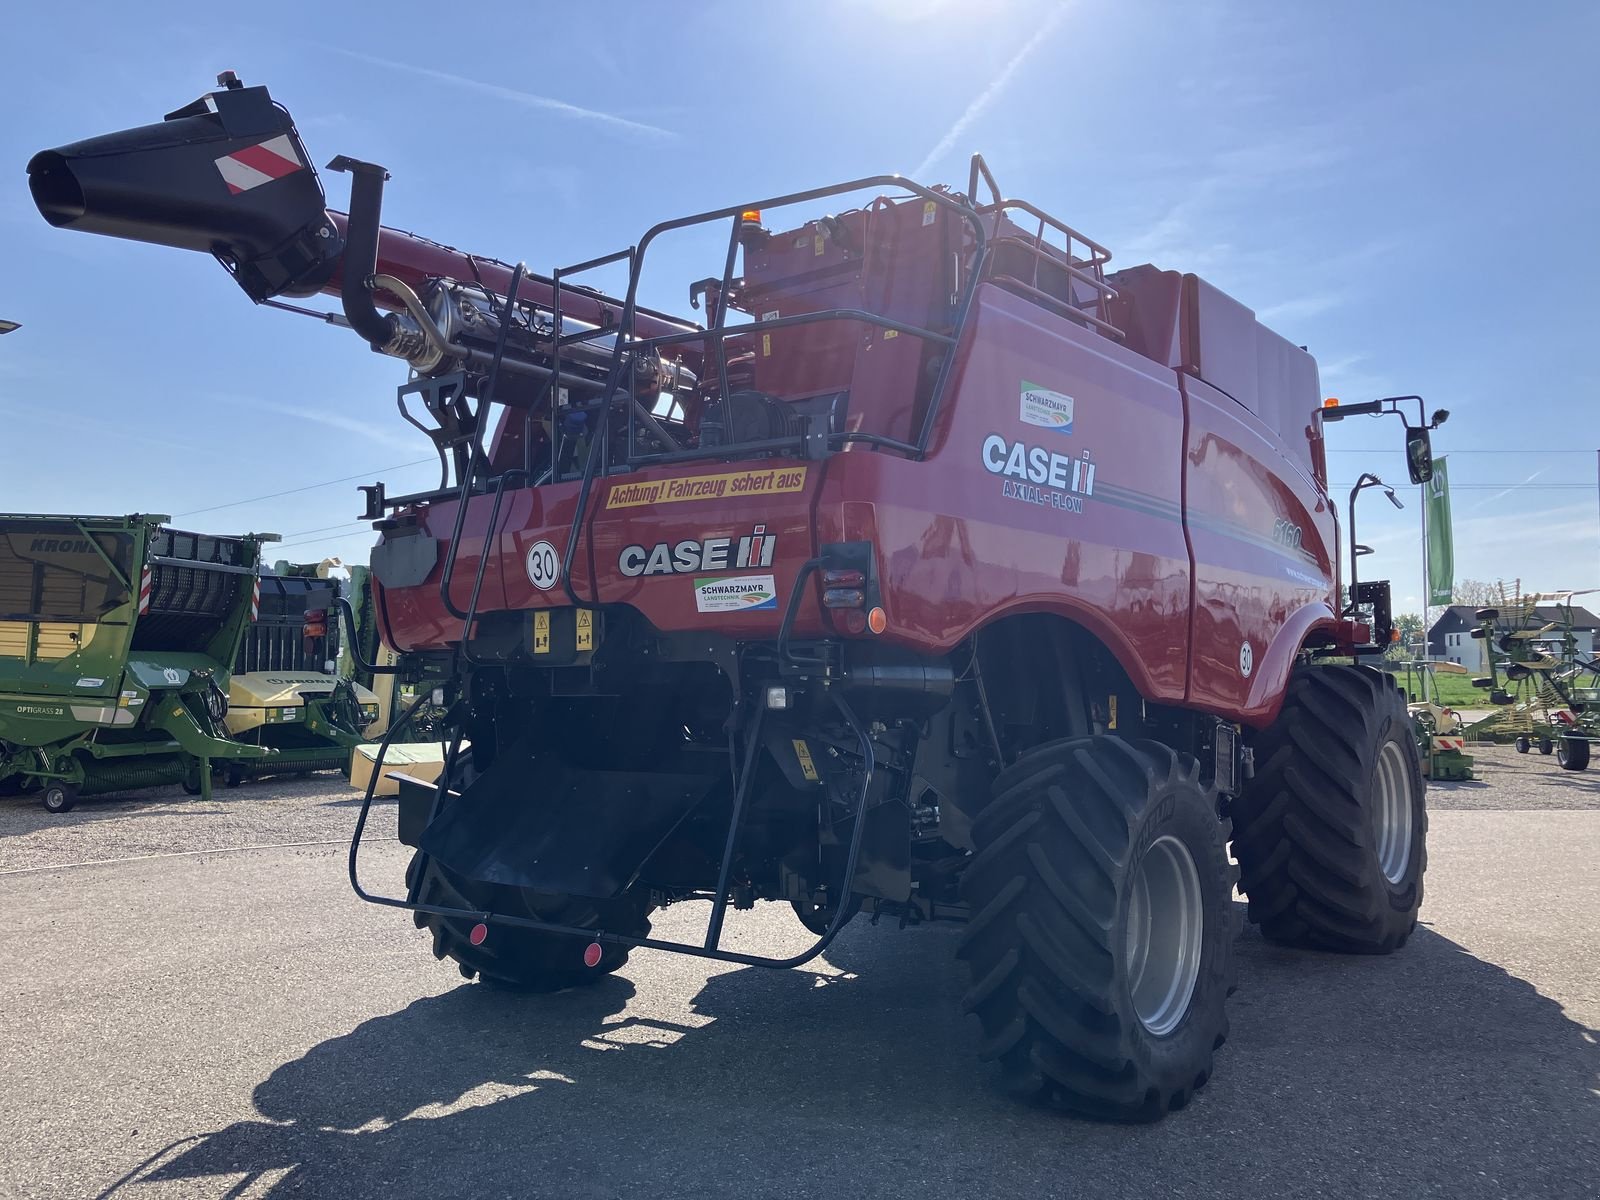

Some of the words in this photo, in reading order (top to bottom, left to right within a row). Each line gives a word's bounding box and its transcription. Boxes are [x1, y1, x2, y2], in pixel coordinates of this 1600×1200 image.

[1025, 392, 1067, 412] SCHWARZMAYR
[982, 434, 1069, 489] CASE
[609, 483, 665, 505] Achtung!
[667, 478, 727, 499] Fahrzeug
[730, 472, 774, 492] schert
[777, 472, 802, 488] aus
[1272, 516, 1302, 549] 6160
[532, 550, 554, 581] 30
[618, 537, 731, 577] CASE
[701, 584, 764, 595] SCHWARZMAYR
[1242, 648, 1250, 670] 30
[17, 706, 54, 715] OPTIGRASS
